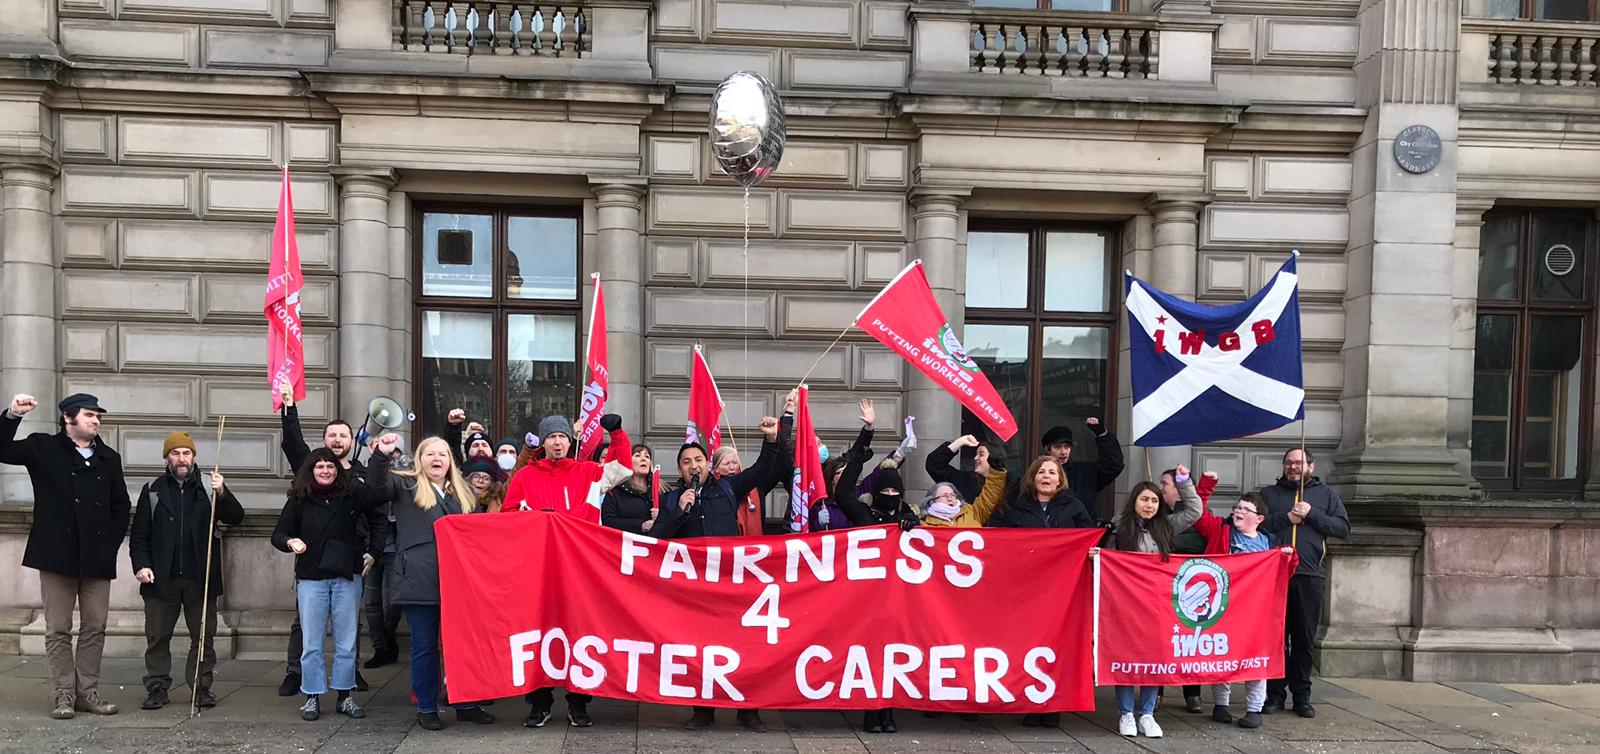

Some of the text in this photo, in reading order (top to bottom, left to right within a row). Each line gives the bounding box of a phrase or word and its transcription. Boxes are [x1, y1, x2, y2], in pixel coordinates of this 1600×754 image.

[872, 319, 1006, 425] PUTTING WORKERS FIRST
[620, 527, 985, 588] FAIRNESS
[741, 583, 790, 645] 4
[509, 627, 1057, 704] FOSTER CARERS
[1111, 656, 1270, 675] PUTTING WORKERS FIRST
